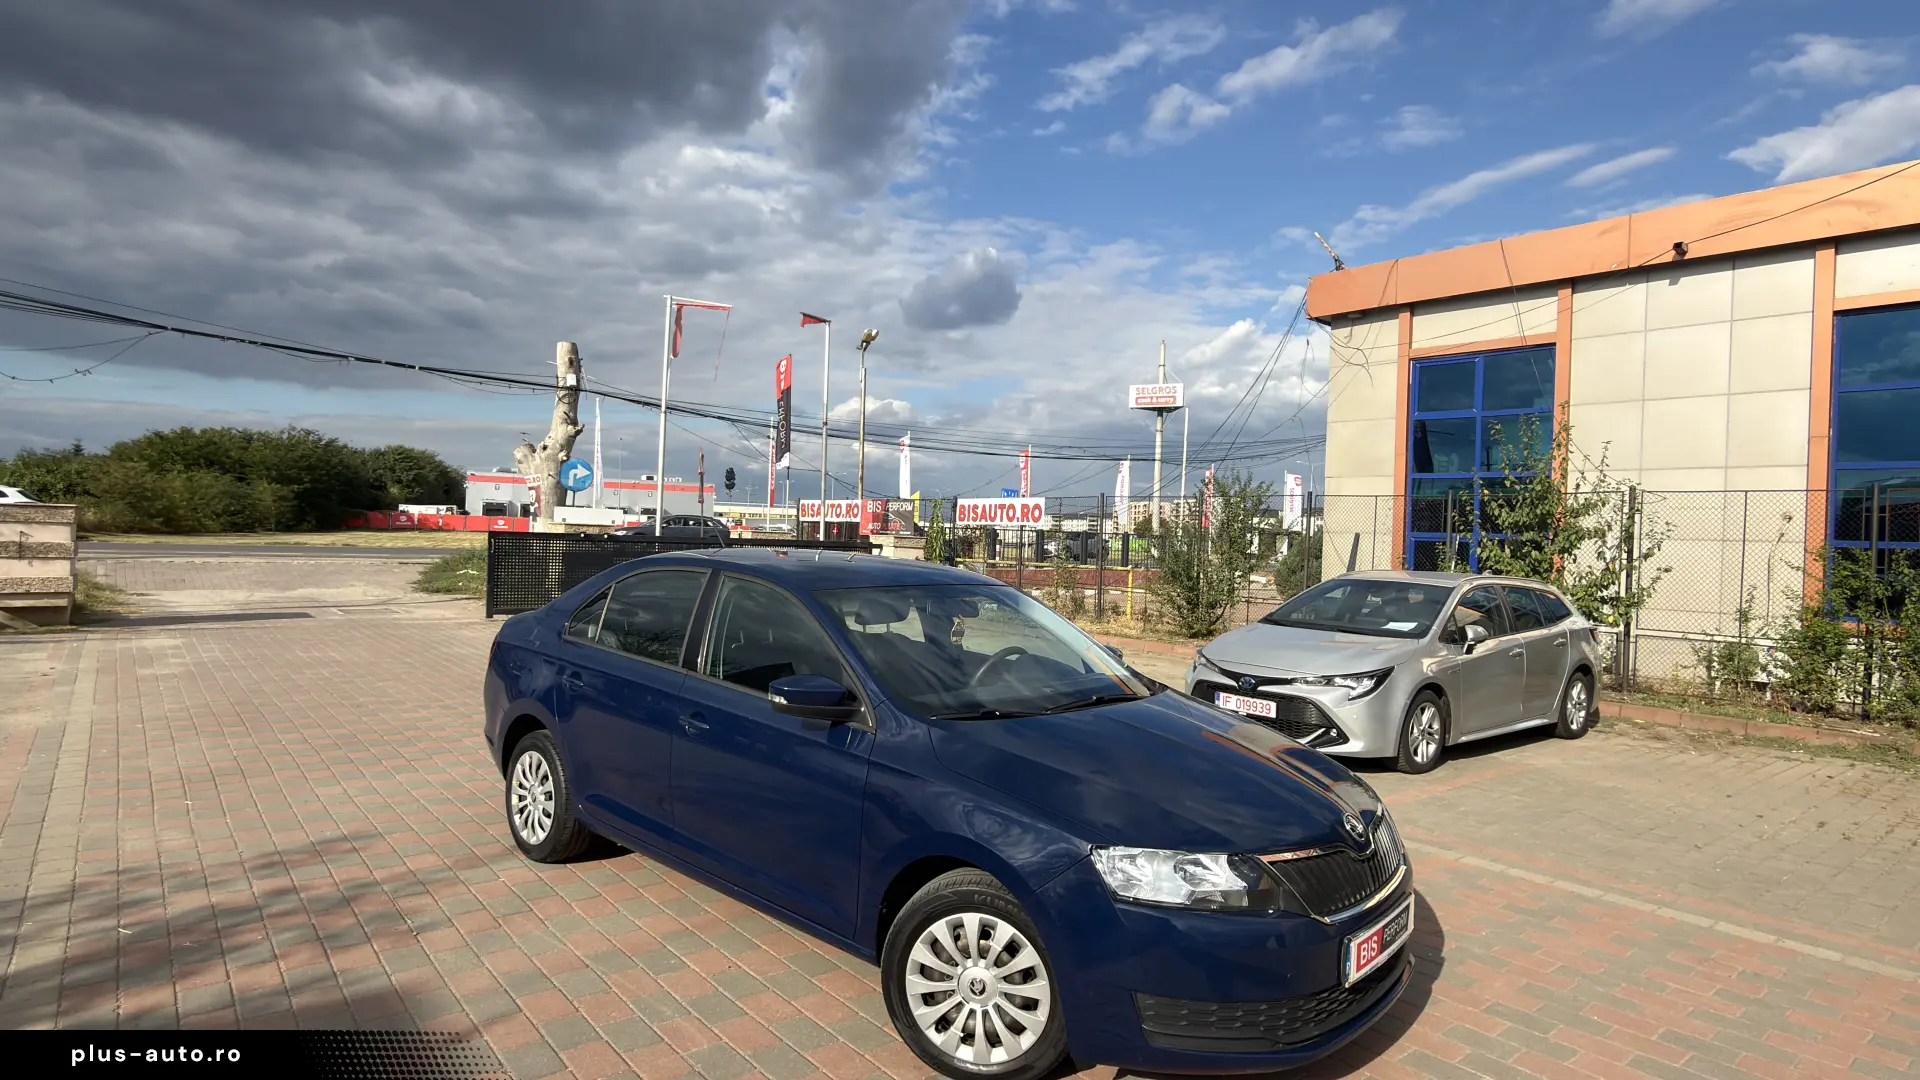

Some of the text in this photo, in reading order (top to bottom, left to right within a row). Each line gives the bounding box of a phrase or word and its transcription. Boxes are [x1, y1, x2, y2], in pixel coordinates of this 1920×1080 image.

[1135, 386, 1178, 396] SELGROS
[867, 501, 882, 512] BIS
[885, 501, 913, 511] PERFORM
[958, 503, 1042, 523] BISAUTO.RO
[1222, 695, 1232, 706] IF
[1235, 697, 1271, 715] 019939
[1360, 935, 1378, 966] BIS
[1382, 909, 1408, 944] PERFORM
